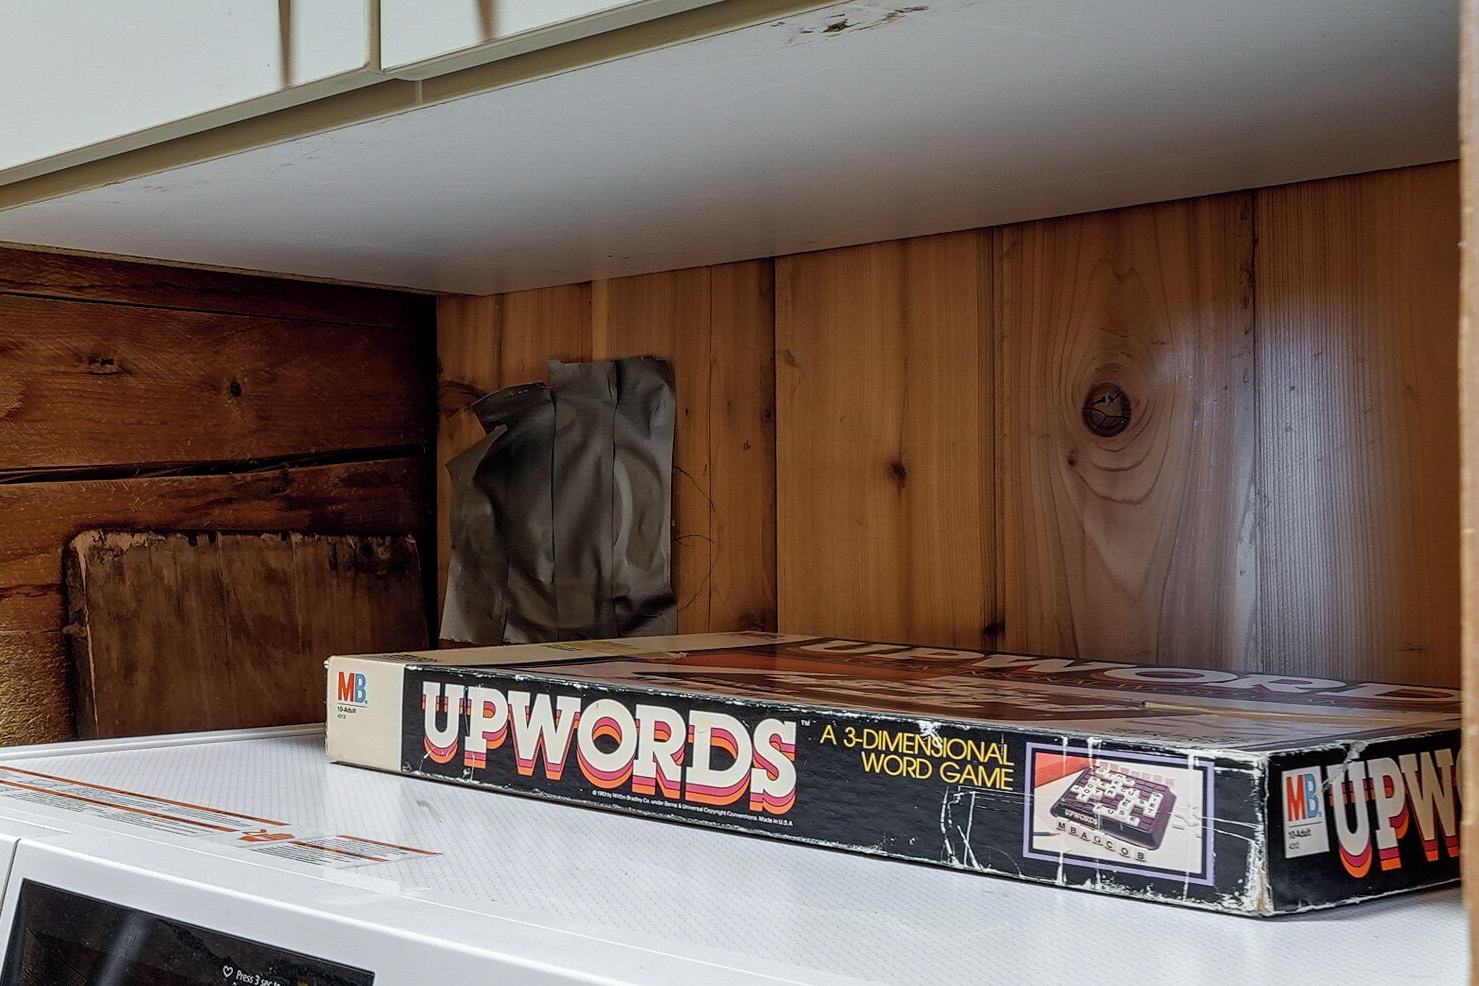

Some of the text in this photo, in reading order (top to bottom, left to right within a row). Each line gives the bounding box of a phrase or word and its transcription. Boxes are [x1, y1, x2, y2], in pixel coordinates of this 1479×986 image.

[422, 681, 797, 813] UPWORDS
[819, 724, 1015, 766] A 3-DIMENSIONAL
[861, 751, 1015, 791] WORD GAME
[1325, 749, 1461, 879] UPW
[236, 970, 254, 984] Press
[254, 975, 261, 985] 3
